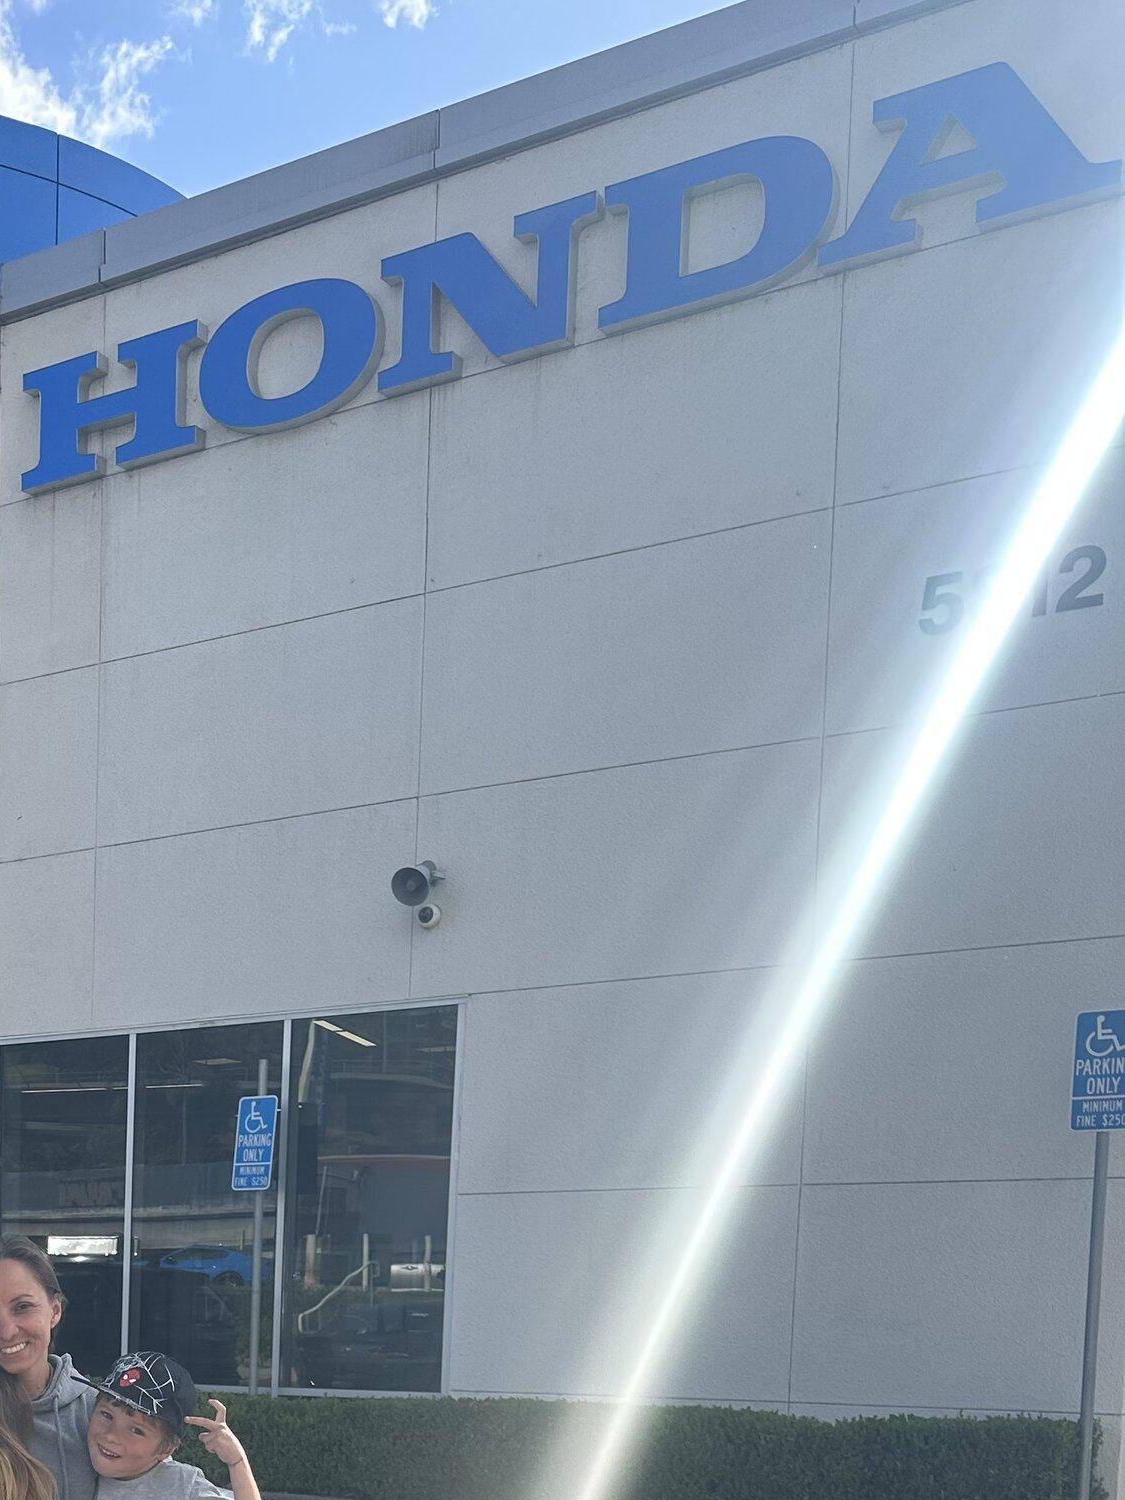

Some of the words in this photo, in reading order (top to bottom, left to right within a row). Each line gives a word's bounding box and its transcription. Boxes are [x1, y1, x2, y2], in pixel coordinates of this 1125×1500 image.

[20, 61, 1124, 495] HONDA
[1086, 1077, 1121, 1094] ONLY
[1082, 1100, 1123, 1113] MINIMUM
[1076, 1115, 1096, 1127] FINE
[238, 1133, 272, 1147] PARKING
[243, 1148, 264, 1162] ONLY
[239, 1166, 265, 1175] MINIMUM
[235, 1177, 248, 1187] FINE
